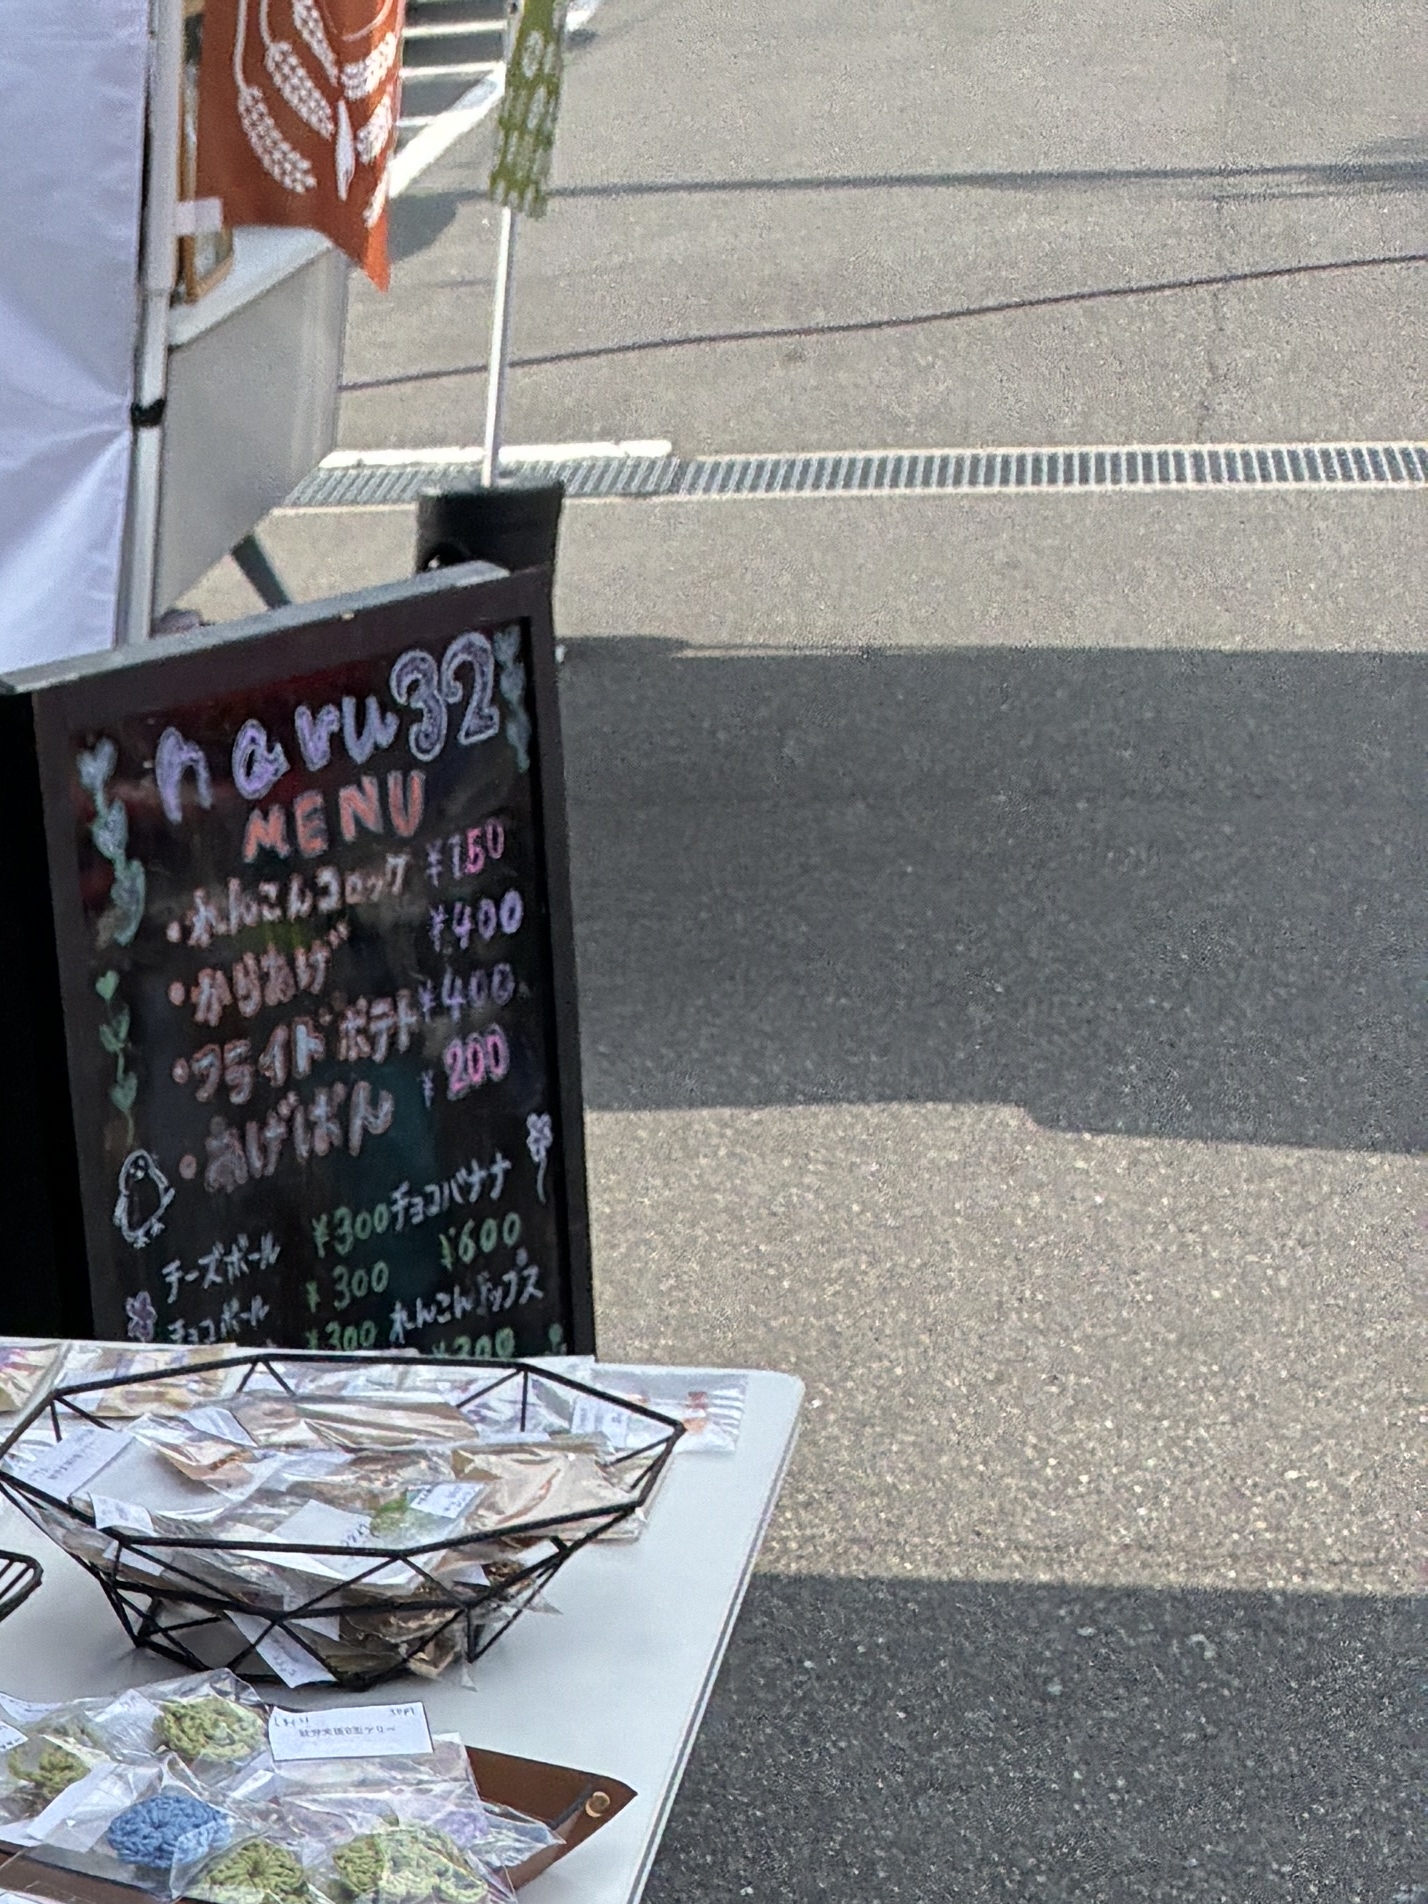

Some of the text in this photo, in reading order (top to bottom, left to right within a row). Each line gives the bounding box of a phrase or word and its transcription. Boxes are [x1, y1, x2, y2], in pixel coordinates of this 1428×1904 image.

[154, 631, 500, 824] naru32
[243, 768, 427, 863] MENU
[426, 887, 525, 952] ¥400
[416, 961, 517, 1024] ¥400
[312, 1203, 390, 1259] ¥300
